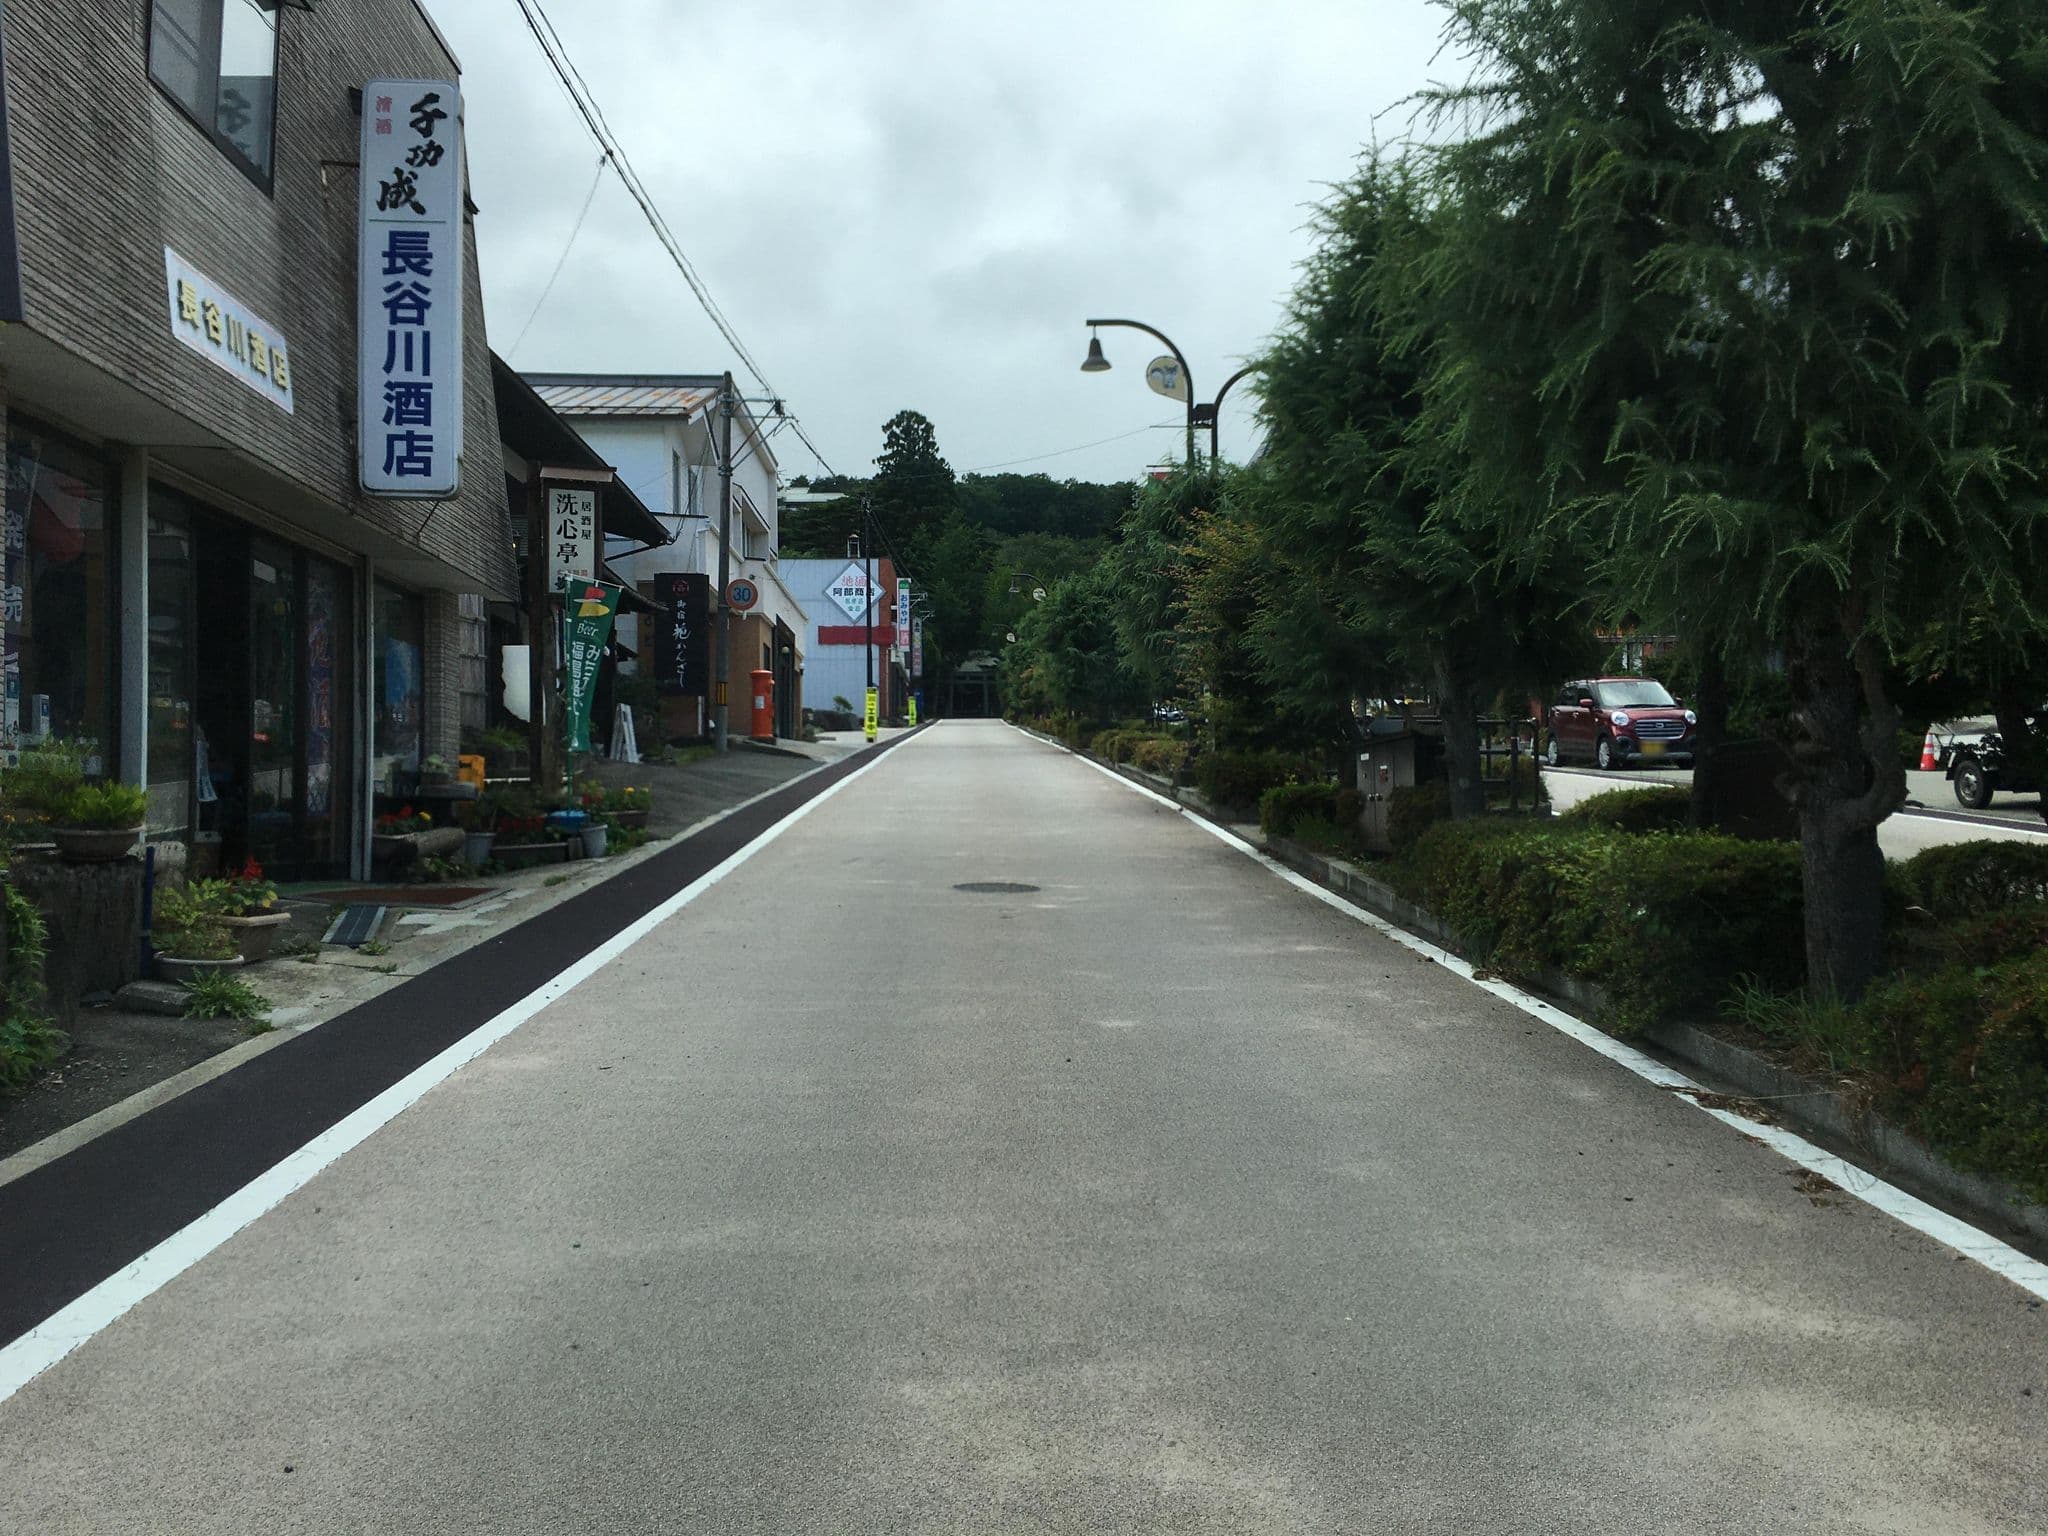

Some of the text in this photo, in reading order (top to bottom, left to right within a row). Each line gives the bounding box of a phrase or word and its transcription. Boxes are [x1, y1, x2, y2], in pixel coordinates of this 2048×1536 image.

[375, 91, 448, 216] 千功成
[177, 278, 290, 391] 長谷川酒店
[382, 230, 434, 478] 長谷川酒店
[556, 493, 579, 564] 洗心亭
[580, 501, 593, 541] 居酒屋
[733, 587, 751, 602] 30
[900, 594, 908, 625] おみやげ
